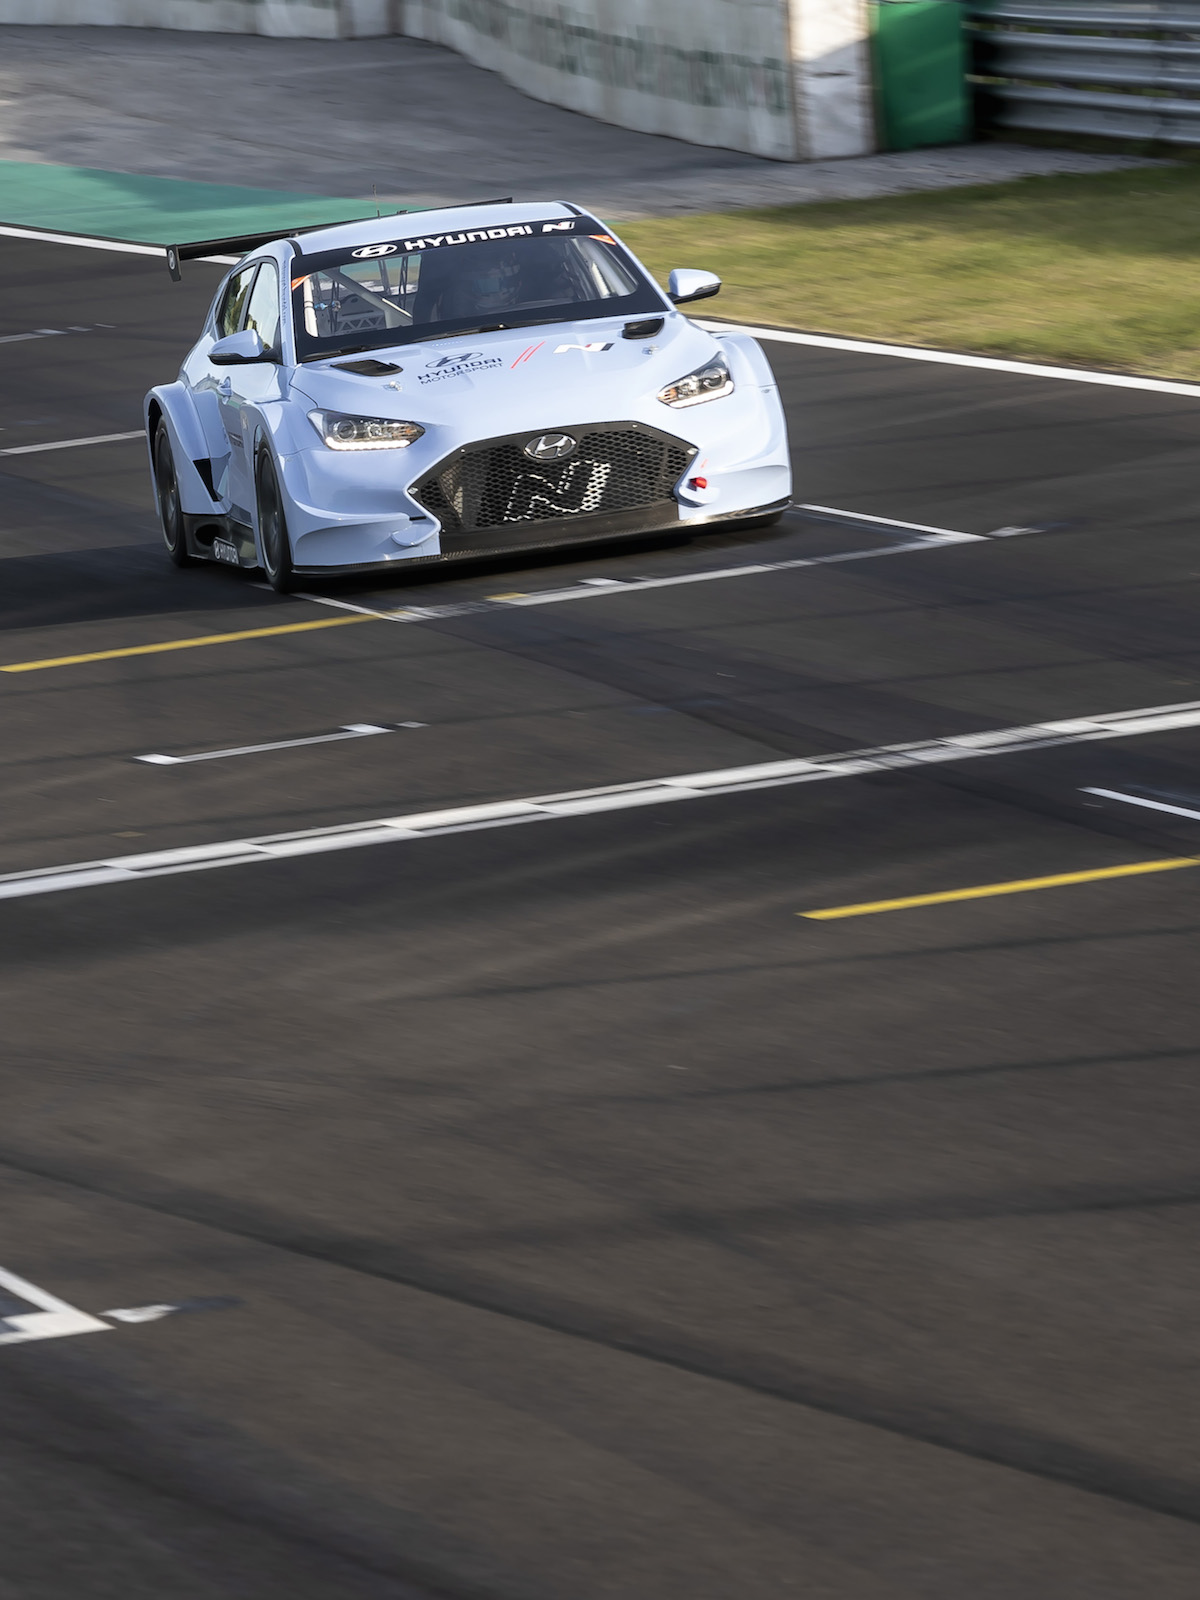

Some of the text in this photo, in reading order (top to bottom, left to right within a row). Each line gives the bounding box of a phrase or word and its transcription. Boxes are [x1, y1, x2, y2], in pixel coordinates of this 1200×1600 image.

[404, 225, 533, 250] HYUNDAI
[417, 357, 502, 380] HYUNDAI
[420, 363, 503, 385] MOTORSPORT
